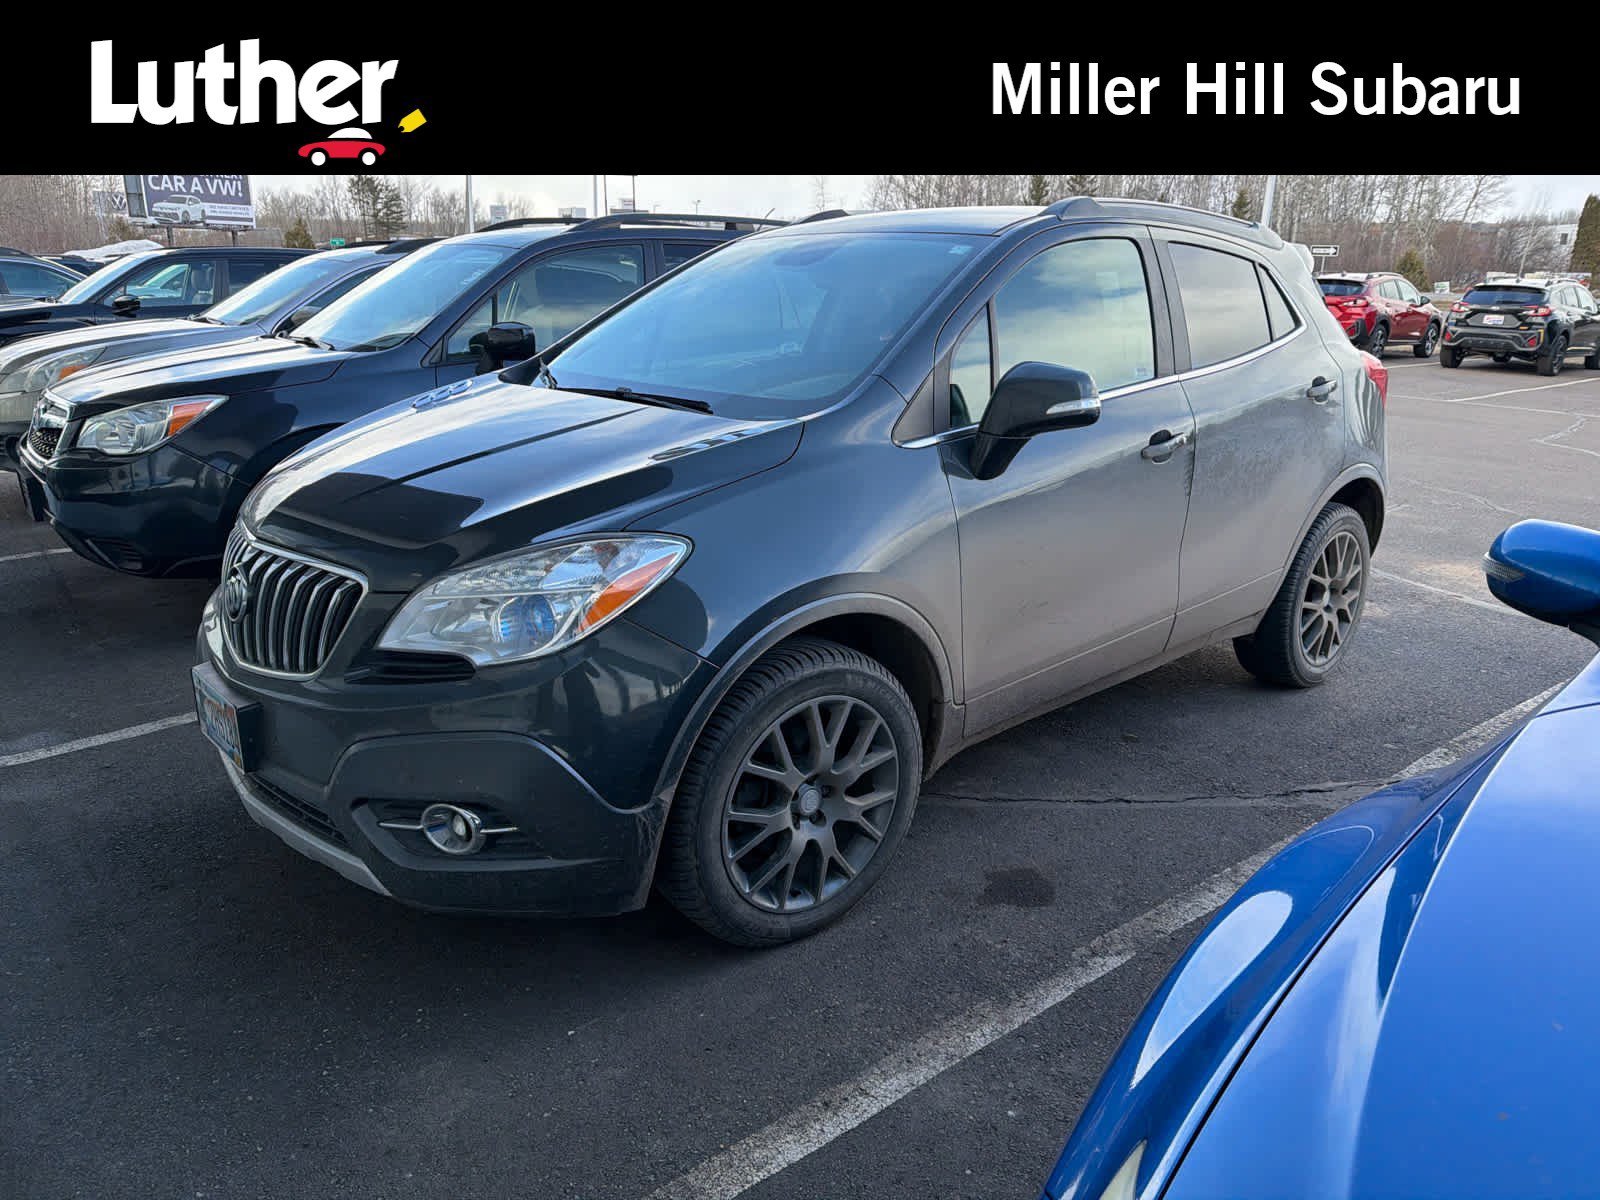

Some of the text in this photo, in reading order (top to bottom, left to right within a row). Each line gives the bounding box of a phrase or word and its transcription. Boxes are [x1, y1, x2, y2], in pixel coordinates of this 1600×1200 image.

[148, 175, 243, 197] CAR A VW!
